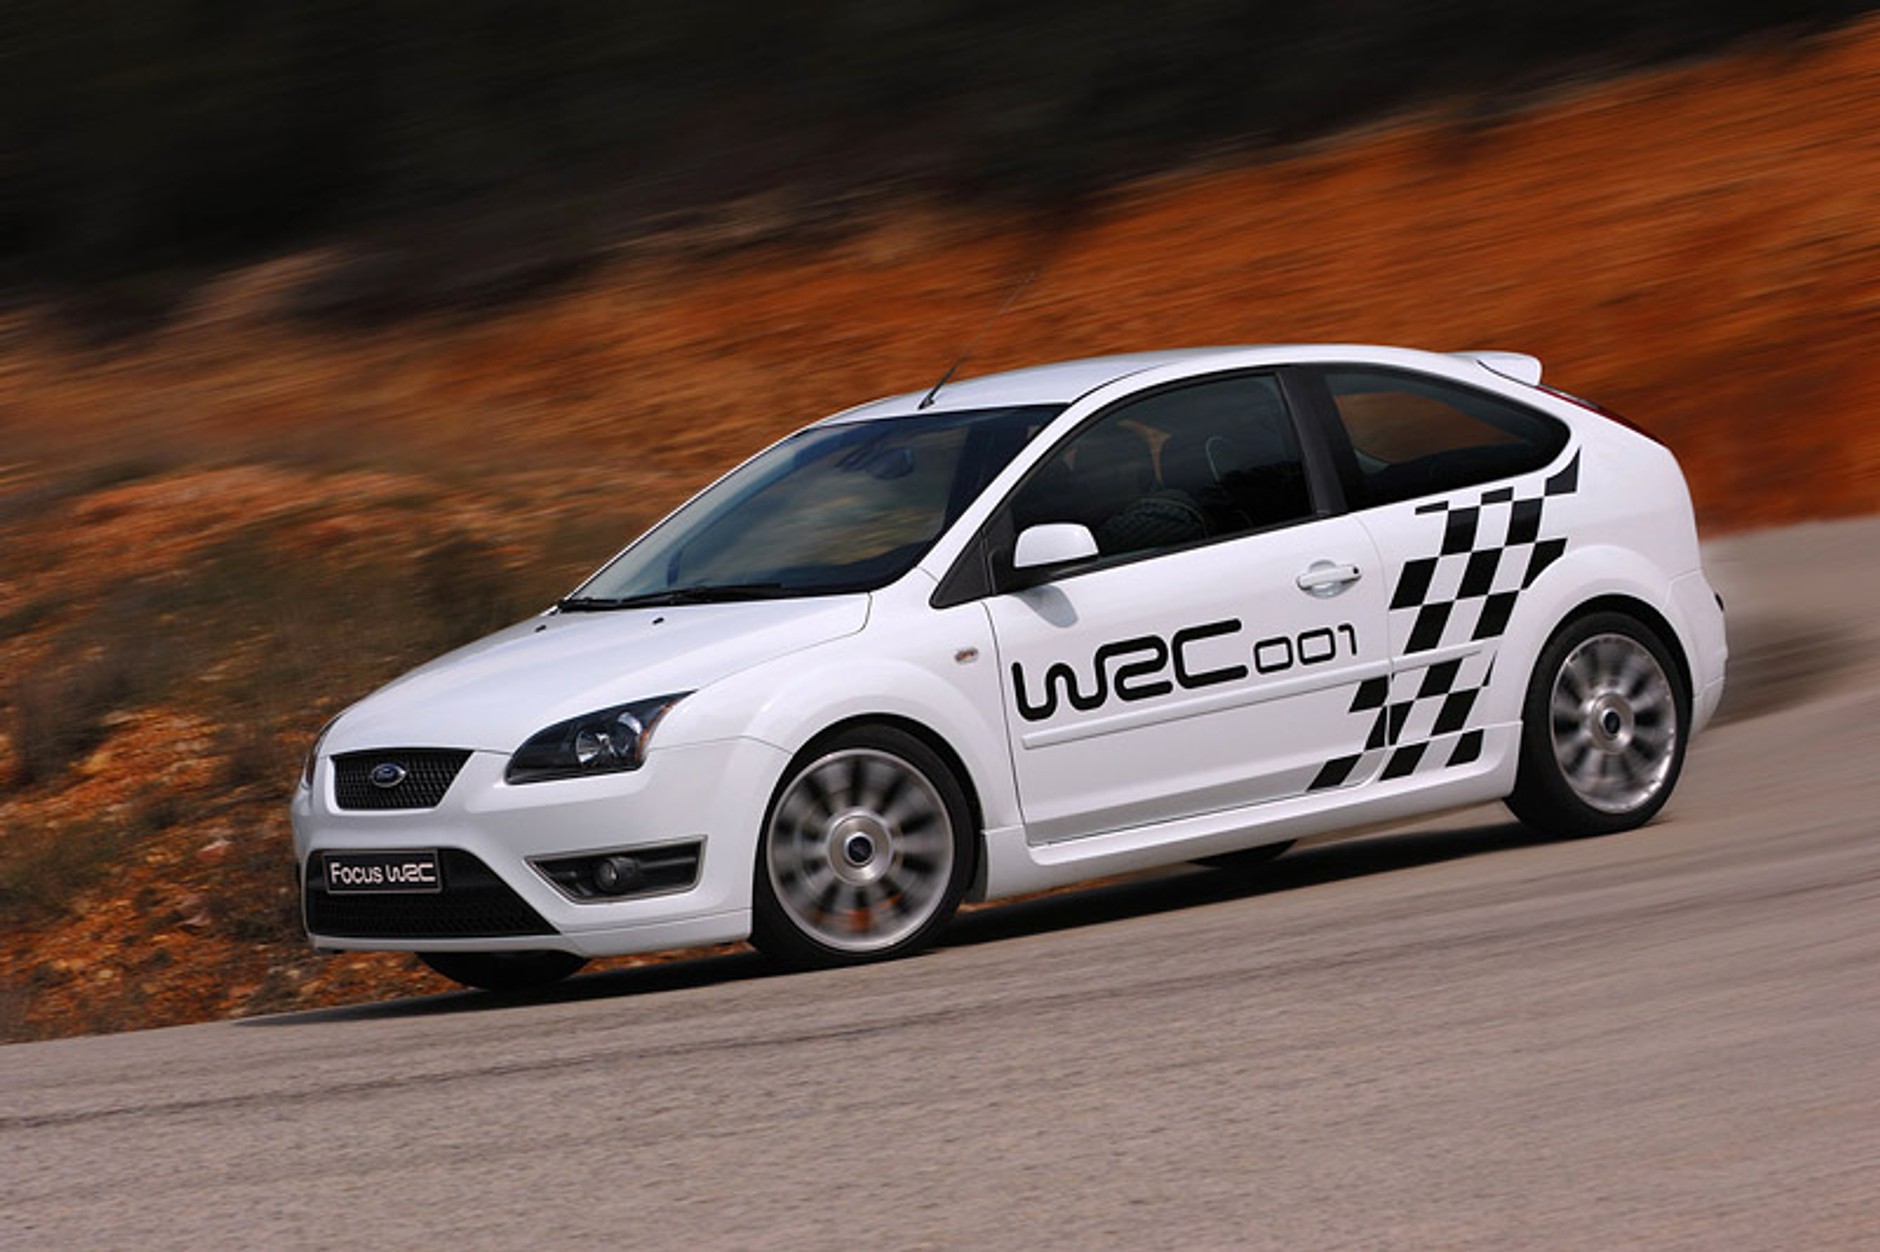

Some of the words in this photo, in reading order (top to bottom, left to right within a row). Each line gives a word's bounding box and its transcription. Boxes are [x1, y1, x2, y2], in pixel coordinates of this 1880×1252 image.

[1011, 618, 1248, 722] WRC
[1253, 623, 1357, 675] 001
[329, 862, 383, 884] Focus
[386, 863, 436, 882] WRC
